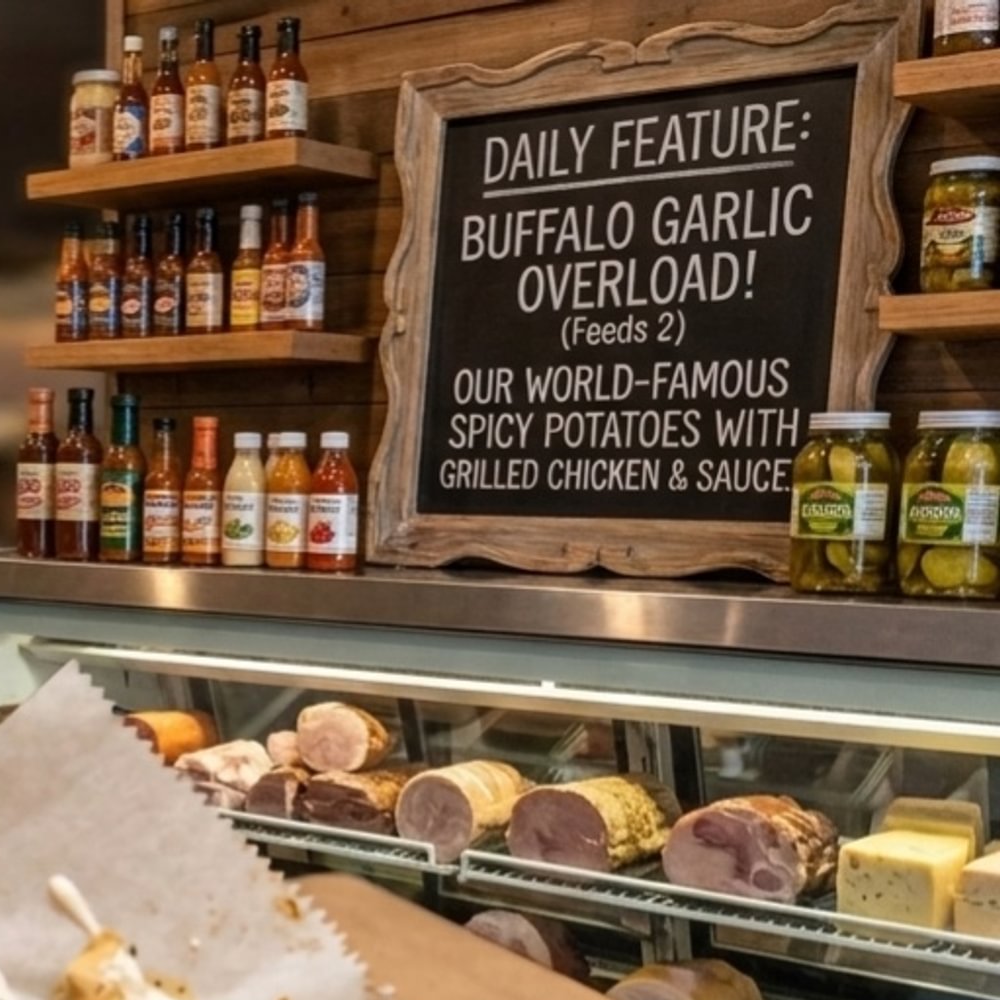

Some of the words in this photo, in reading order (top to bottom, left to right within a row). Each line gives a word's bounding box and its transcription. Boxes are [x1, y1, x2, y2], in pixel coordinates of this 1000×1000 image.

[484, 125, 594, 184] DAILY
[611, 100, 811, 169] FEATURE:
[461, 200, 634, 261] BUFFALO
[652, 184, 813, 245] GARLIC
[517, 250, 756, 312] OVERLOAD!
[561, 315, 647, 350] (Feeds
[657, 310, 686, 345] 2)
[454, 368, 513, 404] OUR
[526, 358, 790, 403] WORLD-FAMOUS
[448, 412, 534, 449] SPICY
[544, 410, 700, 448] POTATOES
[716, 407, 799, 447] WITH
[440, 459, 539, 490] GRILLED
[547, 459, 660, 491] CHICKEN
[668, 459, 688, 491] &
[697, 459, 792, 492] SAUCE.
